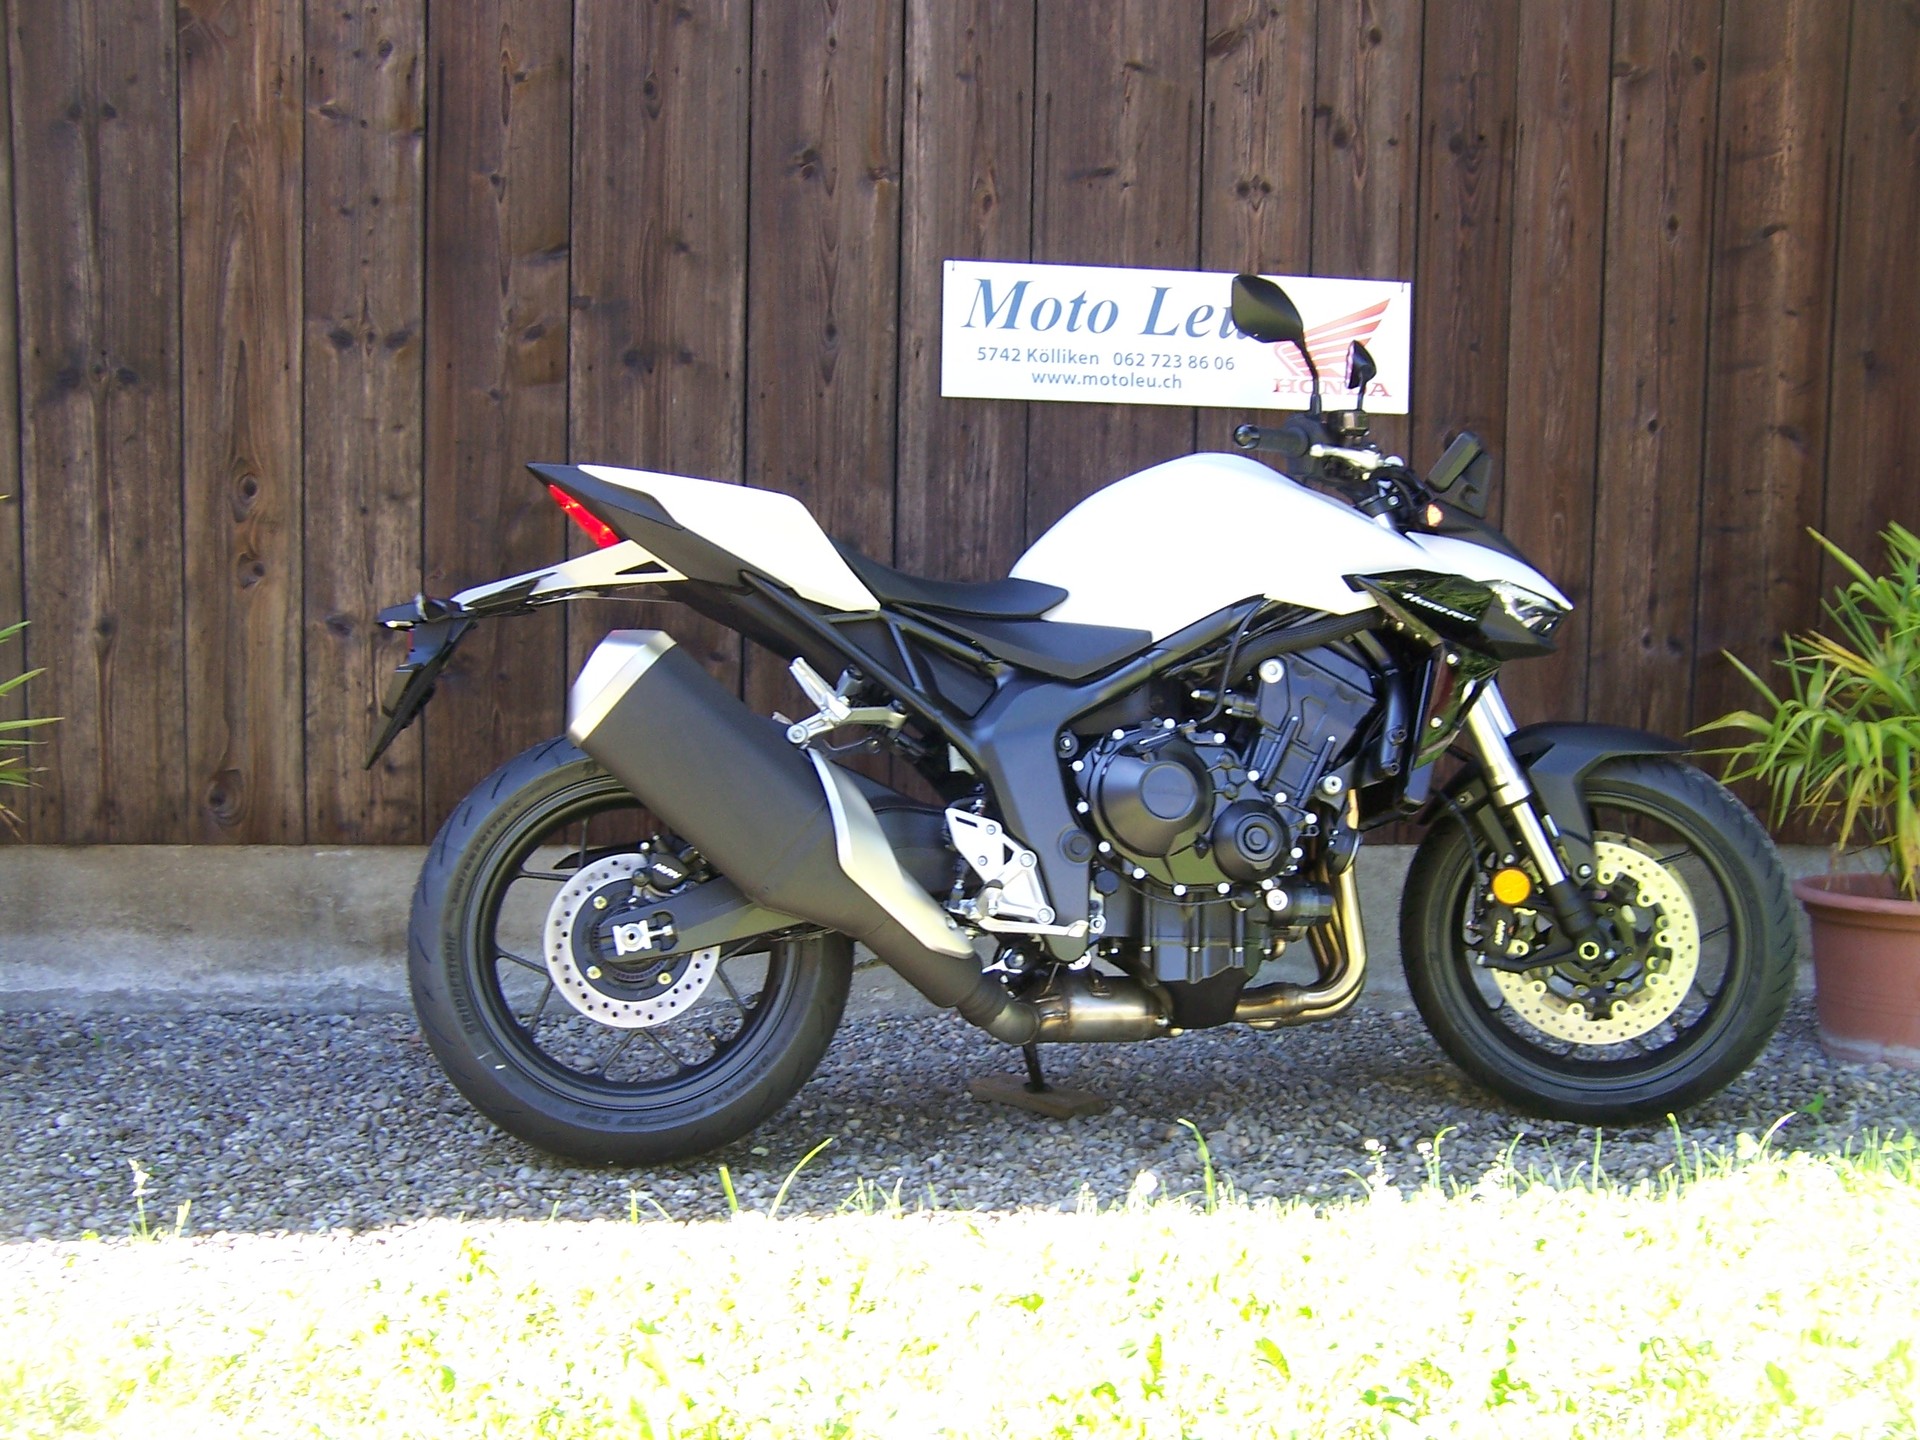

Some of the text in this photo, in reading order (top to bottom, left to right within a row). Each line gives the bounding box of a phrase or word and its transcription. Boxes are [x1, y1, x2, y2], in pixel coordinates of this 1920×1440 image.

[960, 278, 1119, 334] Moto
[977, 346, 1235, 371] 5742 Kölliken 062 723 86 06
[1031, 371, 1182, 389] www.motoleu.ch
[1272, 378, 1392, 397] HONA
